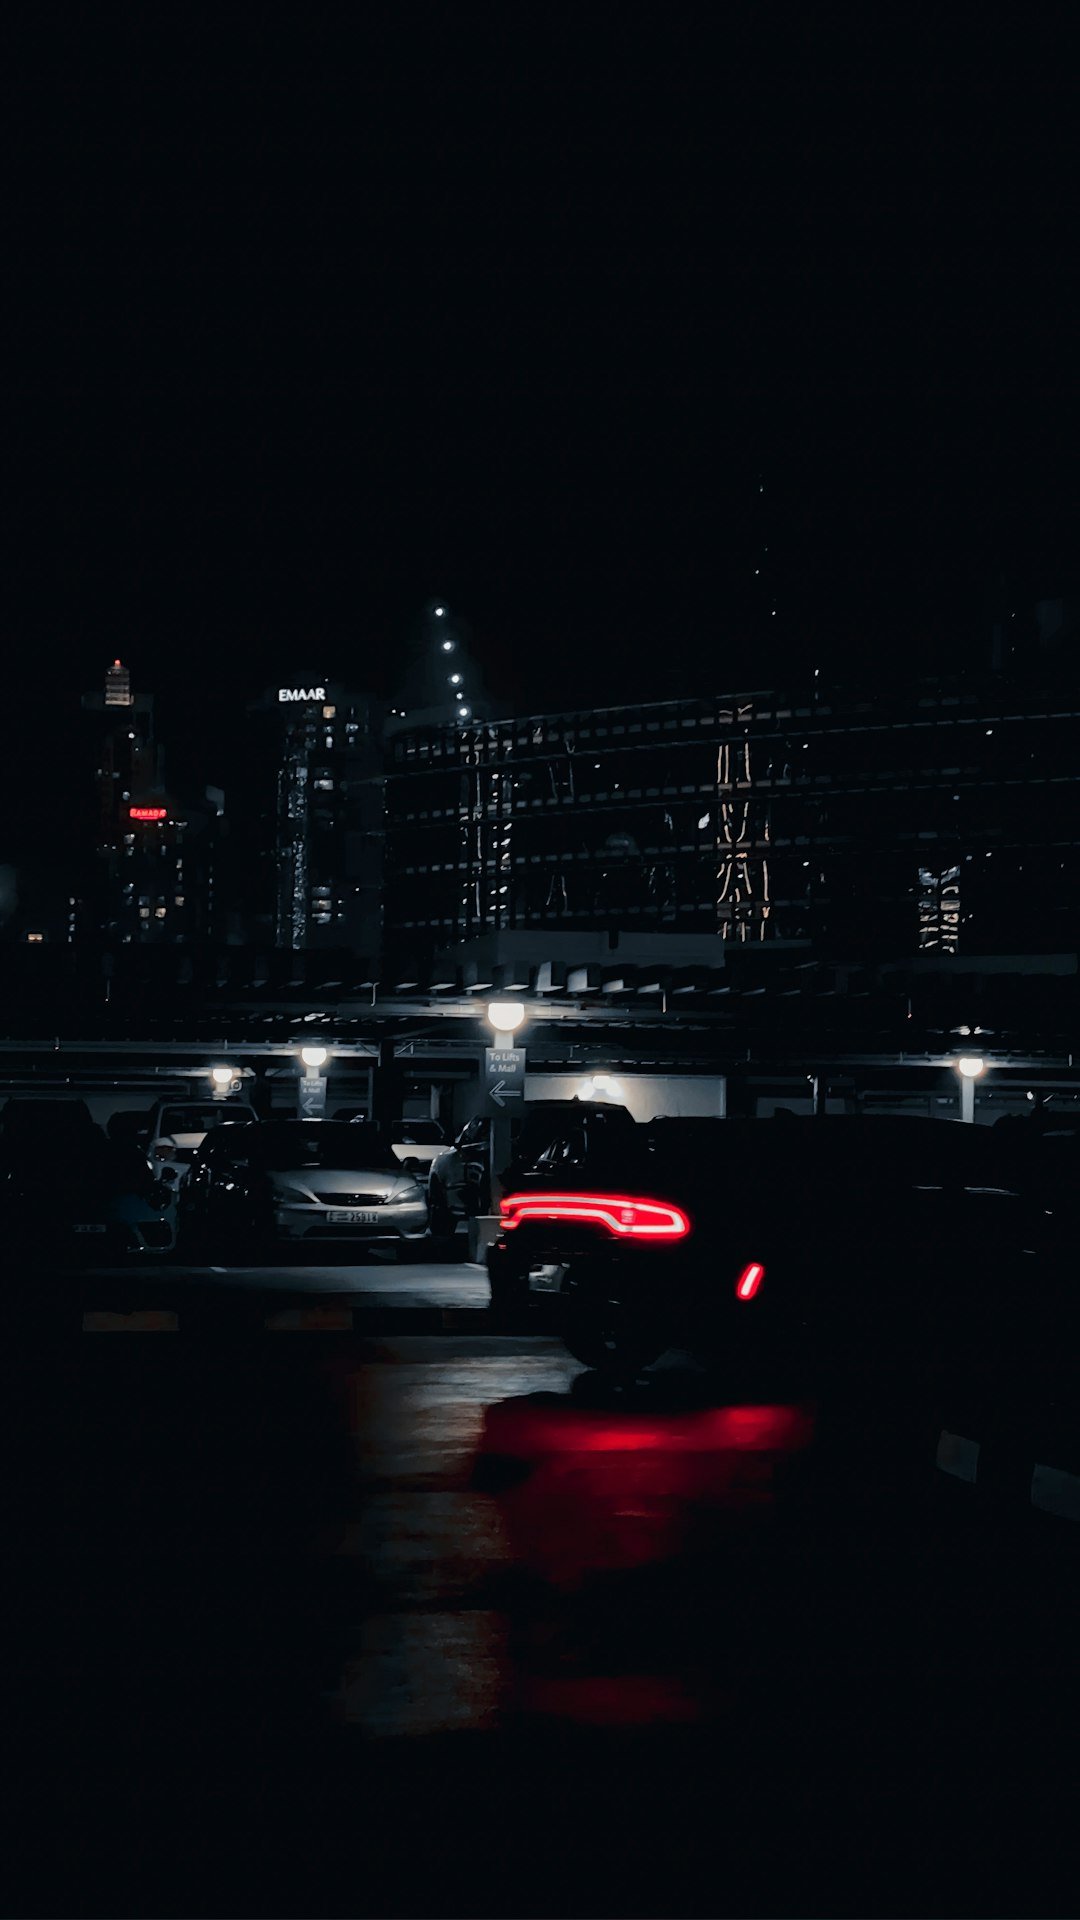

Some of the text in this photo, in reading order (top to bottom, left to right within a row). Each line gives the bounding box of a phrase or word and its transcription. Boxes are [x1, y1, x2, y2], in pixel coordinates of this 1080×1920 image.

[278, 688, 326, 702] EMAAR
[489, 1053, 520, 1061] To Lifts
